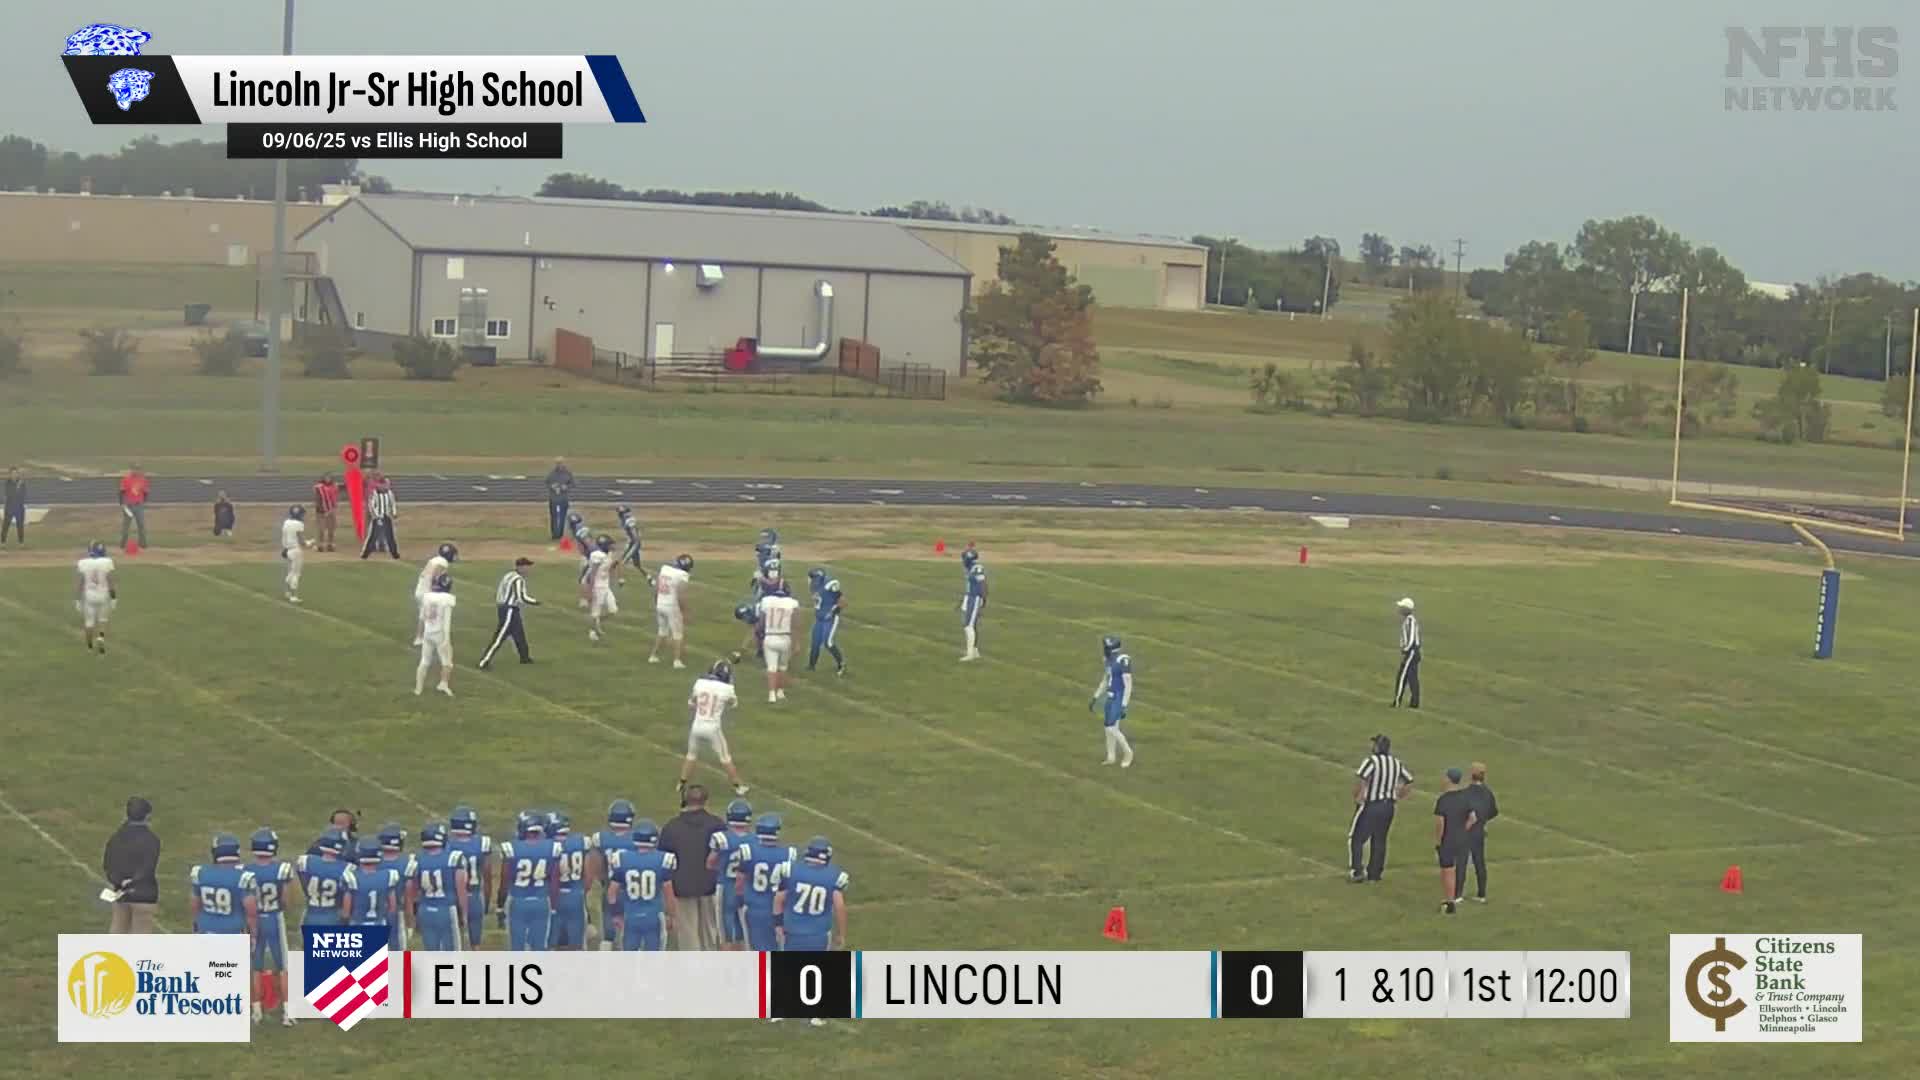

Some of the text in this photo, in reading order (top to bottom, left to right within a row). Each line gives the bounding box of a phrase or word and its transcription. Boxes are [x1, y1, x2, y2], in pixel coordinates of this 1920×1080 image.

[420, 868, 445, 898] 41
[514, 858, 548, 887] 24
[625, 869, 657, 901] 60
[306, 875, 337, 908] 42
[367, 889, 378, 919] 1
[793, 882, 827, 915] 70
